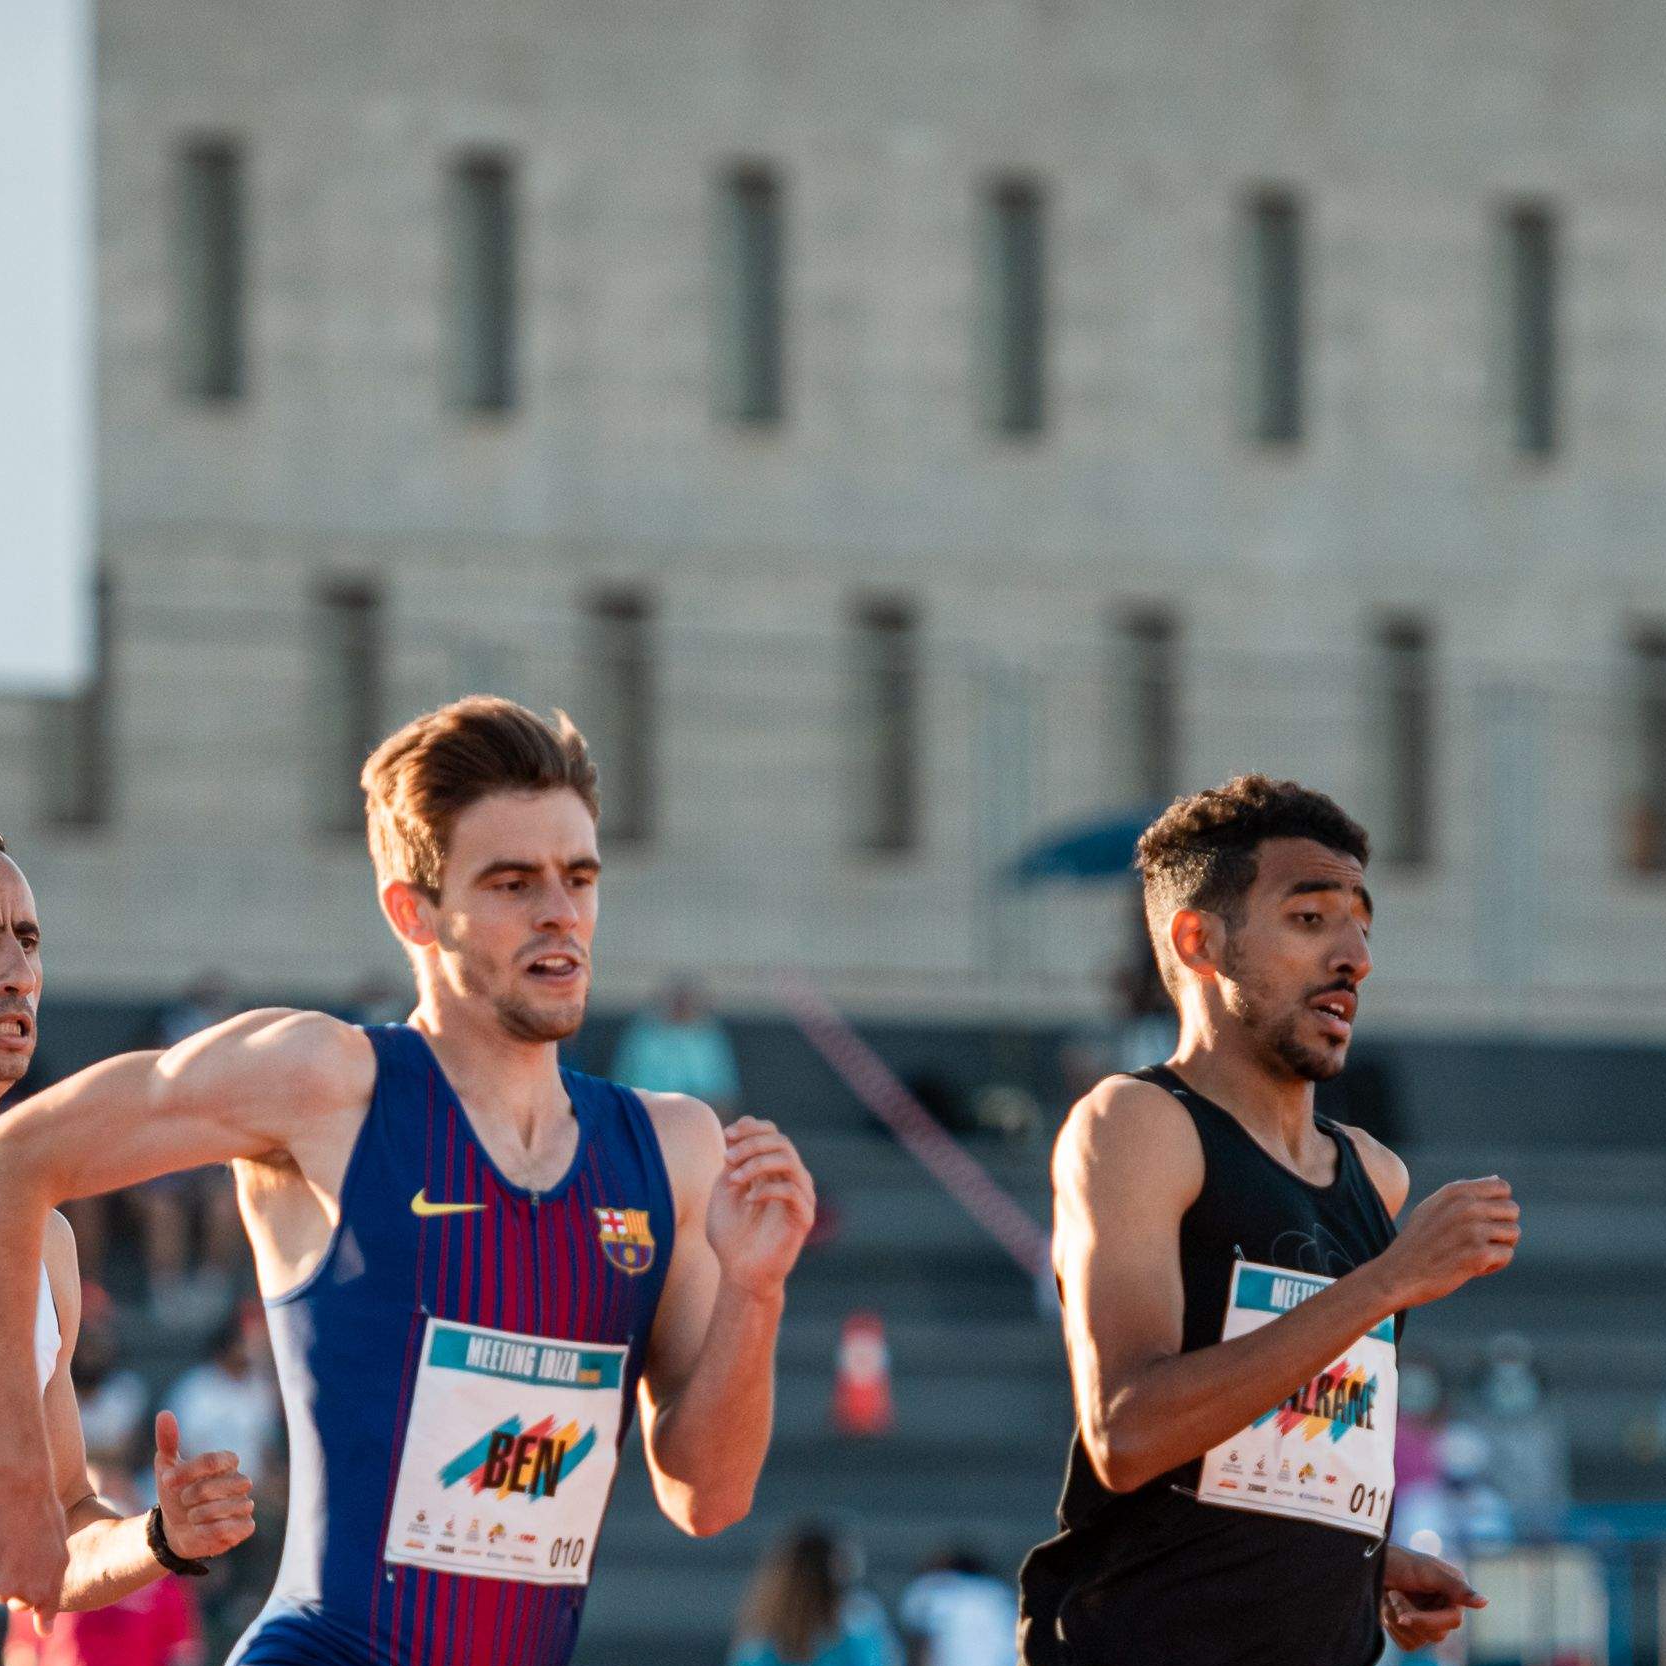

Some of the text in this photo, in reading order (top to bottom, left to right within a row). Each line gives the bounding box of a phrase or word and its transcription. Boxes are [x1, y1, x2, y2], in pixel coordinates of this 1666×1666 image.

[466, 1336, 536, 1376] MEETING
[538, 1348, 579, 1382] IBIZA
[480, 1430, 566, 1498] BEN
[1349, 1483, 1386, 1519] 011
[549, 1536, 585, 1568] 010
